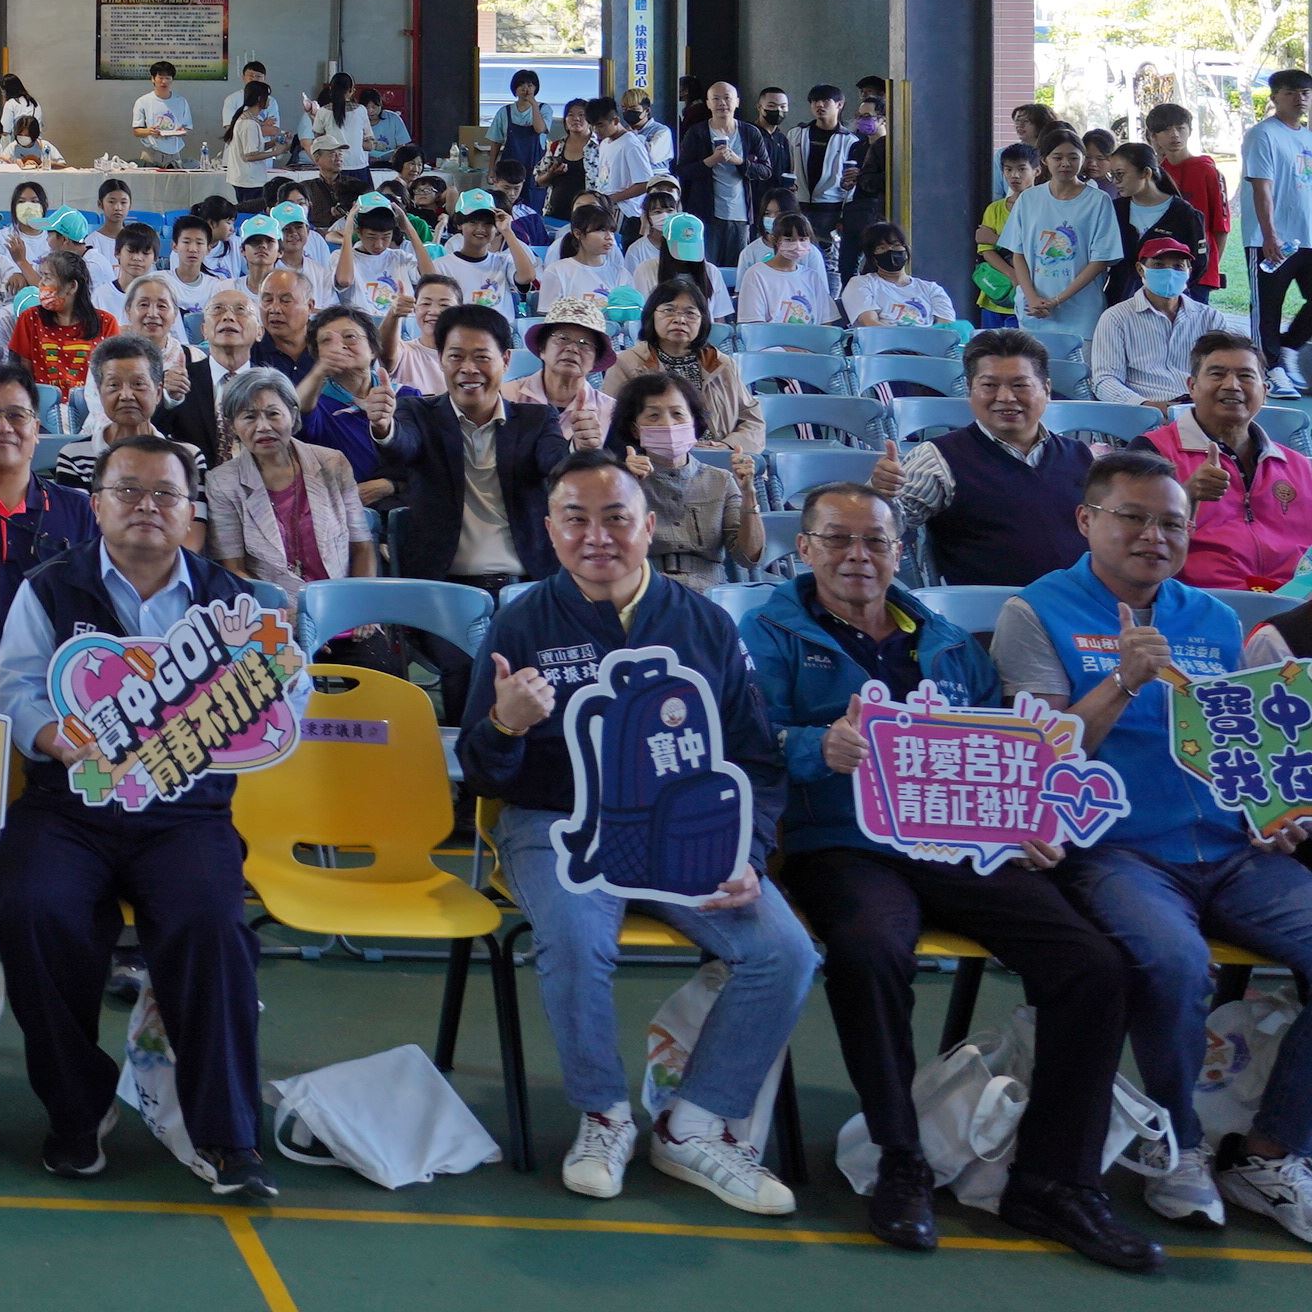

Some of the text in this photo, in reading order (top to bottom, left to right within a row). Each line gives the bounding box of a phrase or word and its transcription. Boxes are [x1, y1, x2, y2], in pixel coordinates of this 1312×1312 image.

[540, 645, 593, 662] 寶山鄉長
[1174, 645, 1220, 658] 立法委員
[137, 648, 281, 796] 青春不打烊
[647, 727, 706, 776] 寶中
[893, 734, 1038, 787] 我愛莒光
